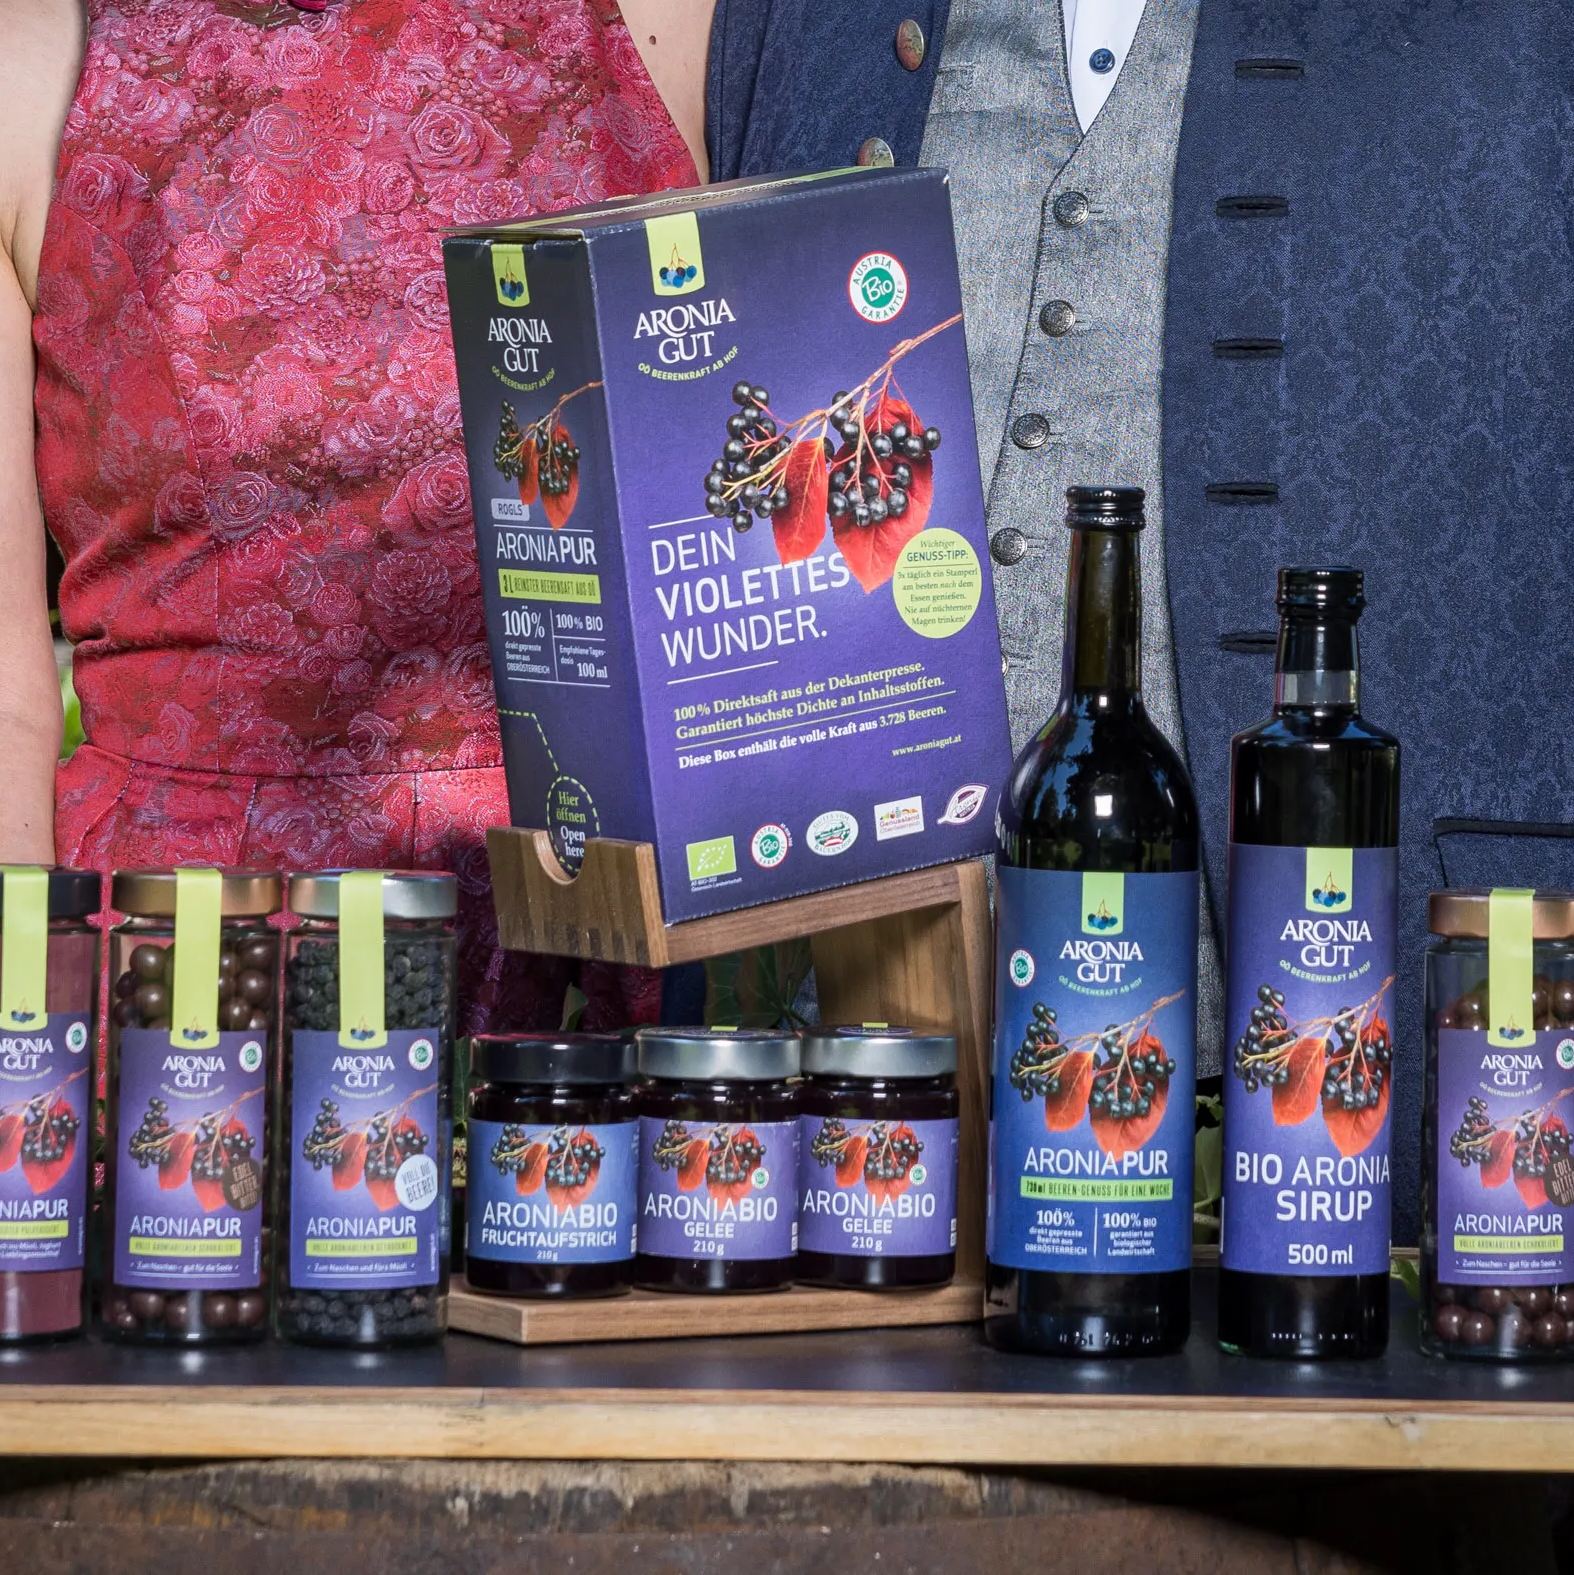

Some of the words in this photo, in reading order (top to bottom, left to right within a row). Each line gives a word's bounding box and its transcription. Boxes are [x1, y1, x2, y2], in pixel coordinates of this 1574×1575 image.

[852, 256, 892, 285] AUSTRIA
[861, 276, 894, 302] Bio
[861, 287, 905, 320] GARANTIE
[633, 298, 736, 339] ARONIA
[488, 317, 552, 348] ARONIA
[658, 331, 715, 364] GUT
[504, 347, 539, 372] GUT
[651, 365, 711, 381] BEERENKRAFT
[712, 359, 724, 371] AB
[724, 346, 739, 365] HOF
[651, 527, 736, 576] DEIN
[920, 540, 955, 549] Wichtiger
[907, 549, 968, 562] GENUSS-TIPP:
[907, 570, 931, 579] täglich
[946, 568, 977, 578] Stamperl
[655, 552, 850, 621] VIOLETTES
[915, 582, 938, 590] besten
[958, 580, 973, 588] dem
[910, 594, 930, 602] Essen
[932, 592, 966, 602] genießen.
[905, 606, 917, 614] Nie
[919, 605, 931, 613] auf
[933, 604, 972, 612] nüchternen
[586, 616, 603, 632] BIO
[912, 618, 936, 627] Magen
[937, 615, 966, 624] trinken!
[661, 605, 827, 667] WUNDER.
[577, 662, 595, 677] 100
[596, 665, 608, 679] ml
[713, 688, 778, 714] Direktsaft
[780, 686, 802, 701] aus
[804, 682, 826, 696] der
[827, 660, 925, 691] Dekanterpresse.
[676, 716, 743, 740] Garantiert
[746, 706, 794, 726] höchste
[796, 698, 838, 717] Dichte
[840, 694, 856, 706] an
[858, 675, 945, 703] Inhaltsstoffen.
[678, 752, 712, 769] Diese
[714, 748, 737, 763] Box
[738, 738, 778, 758] enthält
[779, 735, 798, 749] die
[799, 729, 827, 745] volle
[828, 722, 858, 740] Kraft
[858, 719, 878, 732] aus
[879, 712, 906, 728] 3.728
[908, 704, 947, 723] Beeren.
[891, 734, 962, 757] www.aroniagut.at
[558, 791, 580, 806] Hier
[556, 808, 586, 823] öffnen
[560, 825, 586, 845] Open
[564, 842, 585, 857] here
[1280, 919, 1372, 946] ARONIA
[1059, 940, 1144, 964] ARONIA
[1300, 945, 1354, 967] GUT
[1076, 962, 1126, 983] GUT
[1291, 966, 1346, 983] BEERENKRAFT
[3, 1054, 40, 1070] GUT
[162, 1055, 226, 1074] ARONIA
[331, 1055, 395, 1074] ARONIA
[1480, 1054, 1543, 1072] ARONIA
[174, 1072, 212, 1088] GUT
[344, 1072, 381, 1088] GUT
[1493, 1070, 1530, 1086] GUT
[1235, 1151, 1283, 1185] BIO
[1291, 1154, 1390, 1186] ARONIA
[1048, 1182, 1112, 1197] BEEREN-GENUSS
[1114, 1184, 1129, 1197] FÜR
[1131, 1184, 1147, 1197] EINE
[1149, 1182, 1170, 1195] WOCHE
[644, 1192, 778, 1222] ARONIABIO
[803, 1188, 936, 1218] ARONIABIO
[1276, 1189, 1373, 1222] SIRUP
[482, 1200, 618, 1229] ARONIABIO
[1143, 1217, 1157, 1228] BIO
[1454, 1213, 1563, 1234] ARONIAPUR
[129, 1215, 242, 1237] ARONIAPUR
[306, 1215, 417, 1237] ARONIAPUR
[684, 1221, 735, 1239] GELEE
[842, 1217, 893, 1234] GELEE
[481, 1228, 617, 1248] FRUCHTAUFSTRICH
[693, 1240, 715, 1253] 210
[716, 1243, 725, 1256] g
[851, 1236, 874, 1249] 210
[875, 1239, 883, 1252] g
[536, 1250, 552, 1260] 210
[1288, 1244, 1328, 1265] 500
[1331, 1244, 1353, 1264] ml
